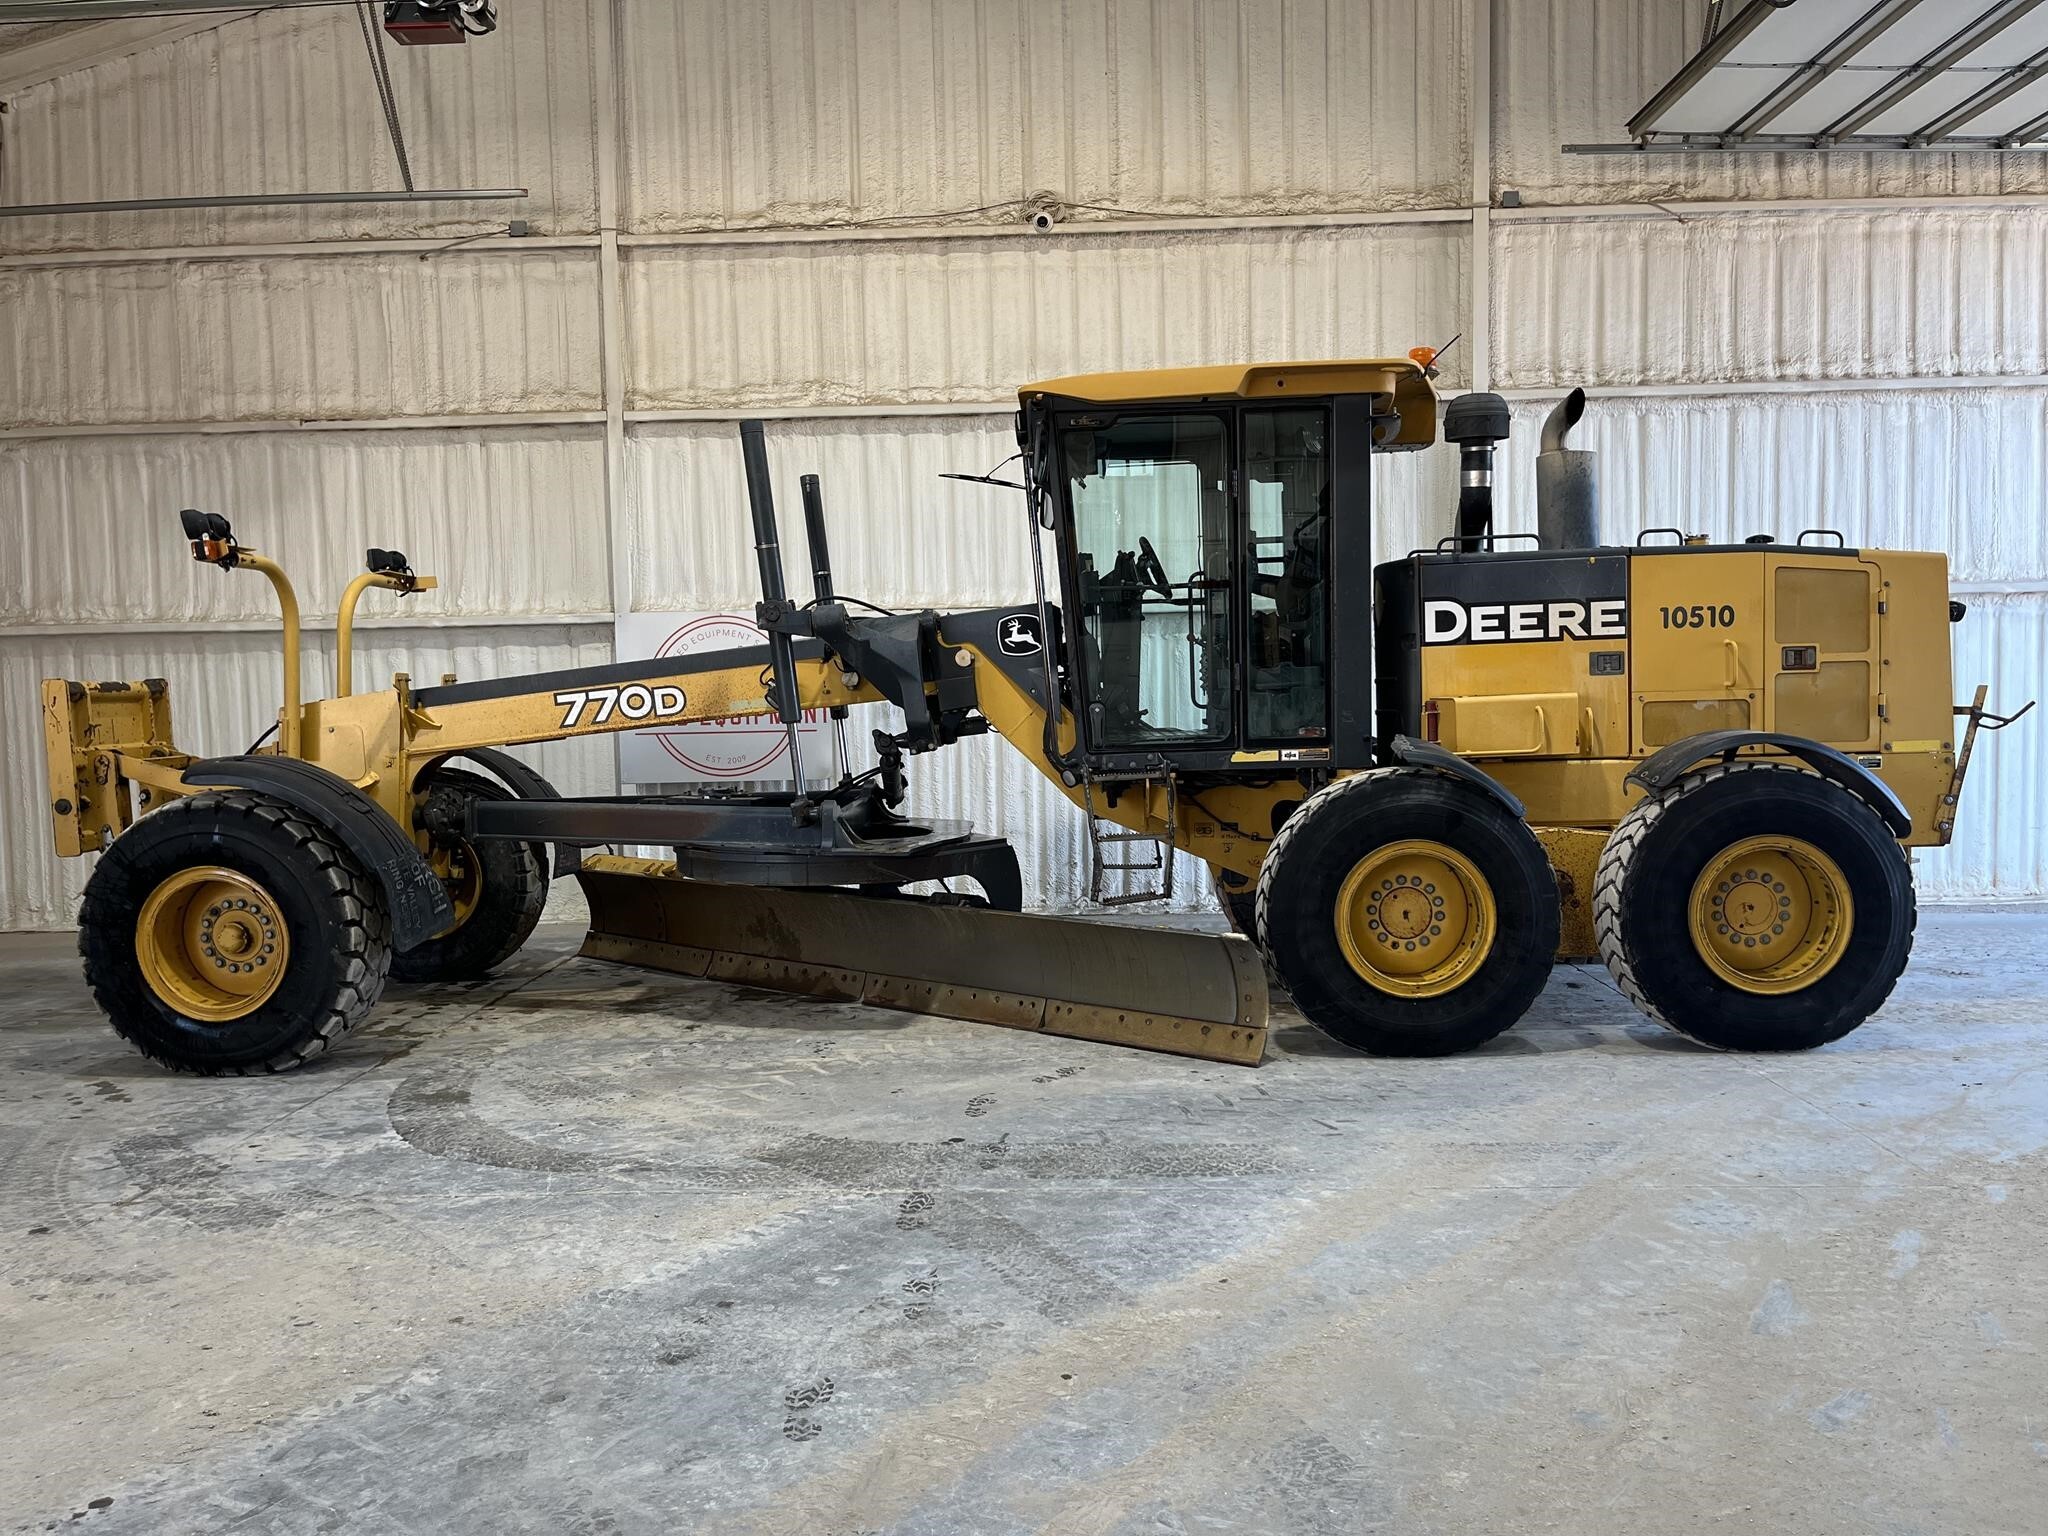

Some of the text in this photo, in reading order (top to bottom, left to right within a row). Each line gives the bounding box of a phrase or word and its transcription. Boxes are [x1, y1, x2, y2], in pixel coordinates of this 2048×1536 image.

[1424, 600, 1626, 643] DEERE
[1659, 604, 1736, 629] 10510
[690, 628, 752, 645] EQUIPMENT
[554, 684, 686, 728] 770D
[705, 754, 746, 765] EST 2009
